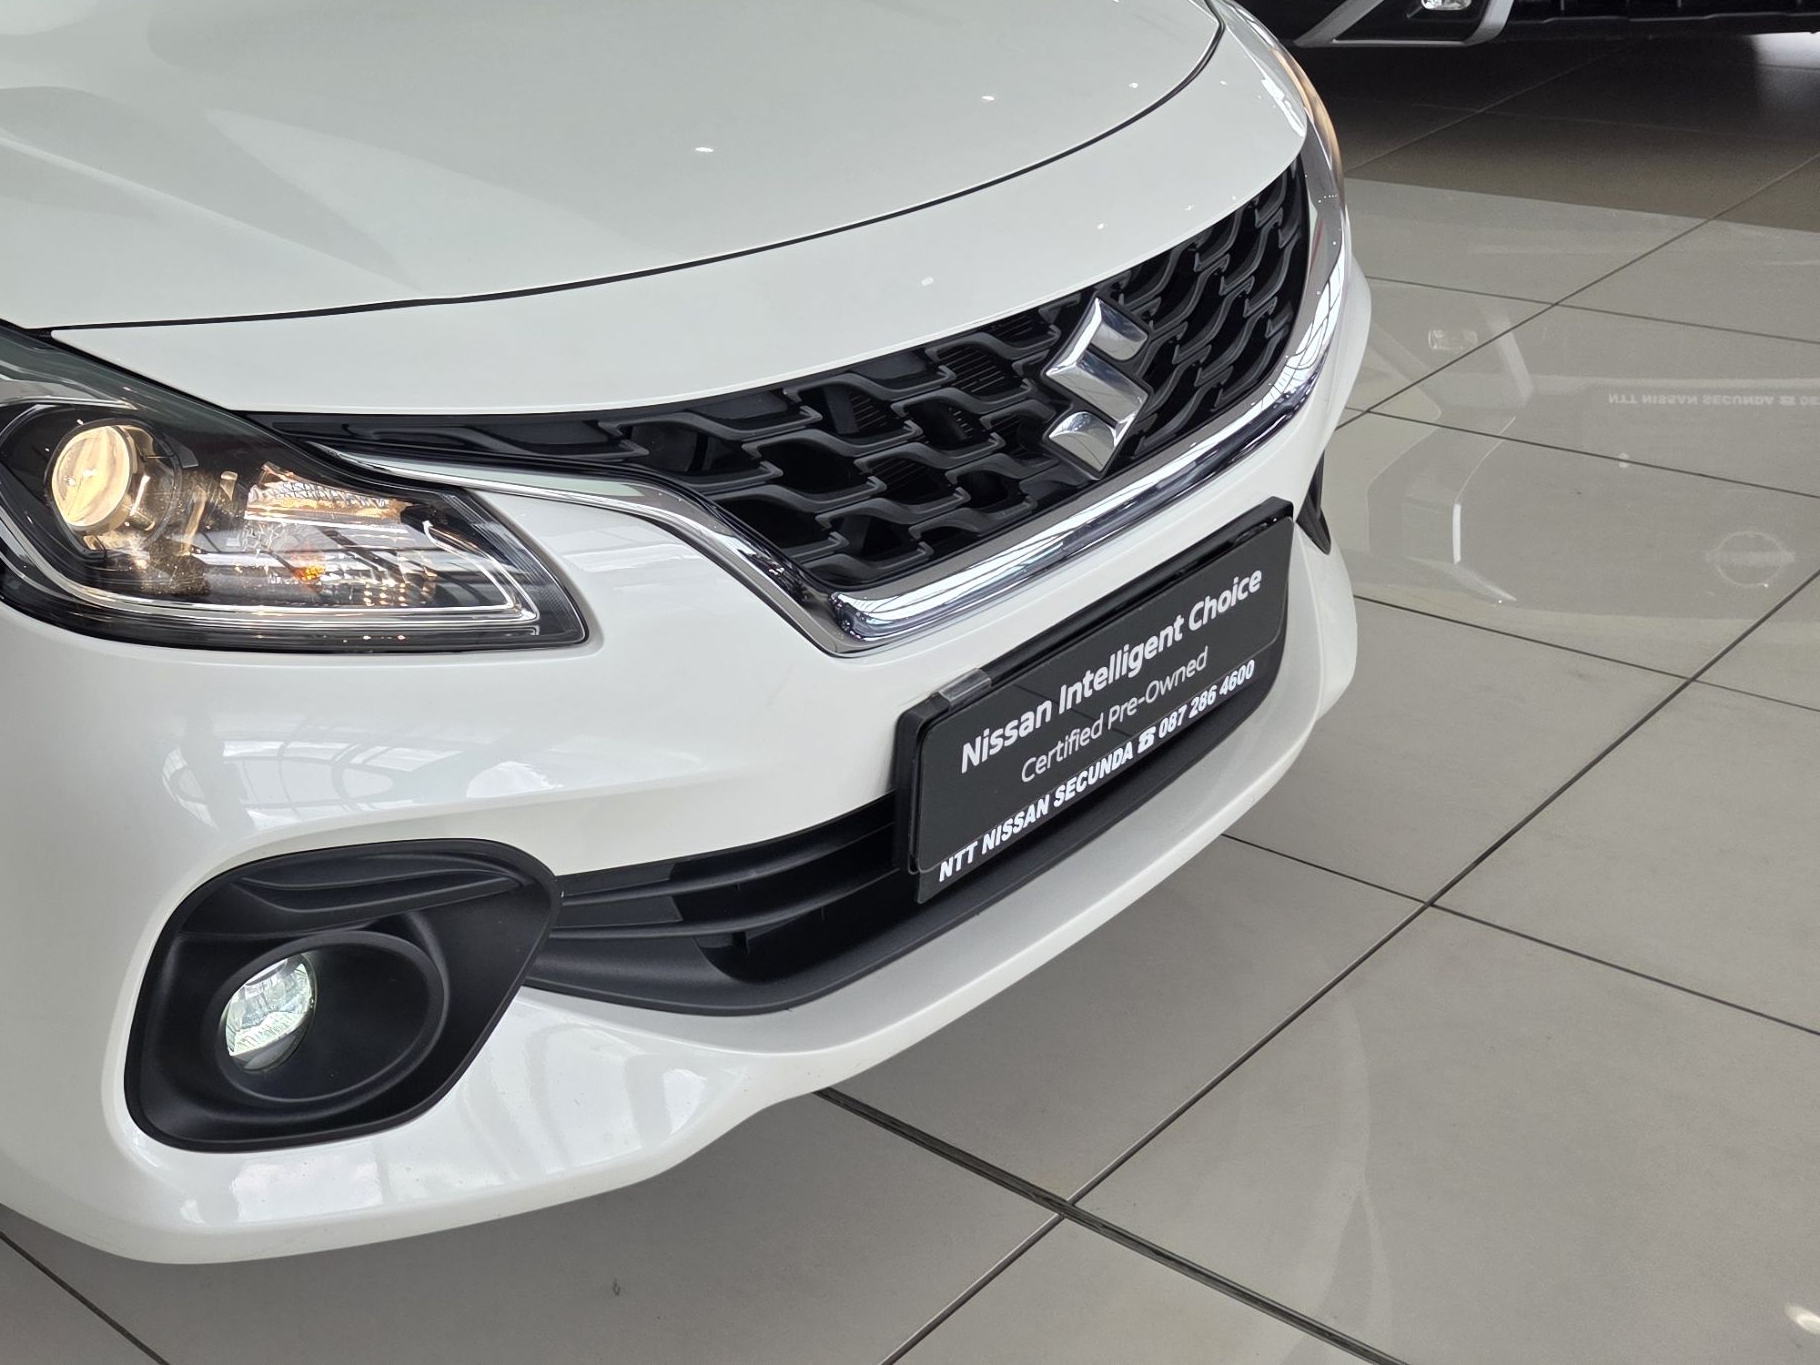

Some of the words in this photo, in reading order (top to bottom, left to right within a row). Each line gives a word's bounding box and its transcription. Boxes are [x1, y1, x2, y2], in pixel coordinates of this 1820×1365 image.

[938, 840, 979, 883] NTT
[981, 795, 1049, 855] NISSAN
[1053, 745, 1134, 808] SECUNDA
[1158, 710, 1187, 740] 087
[1189, 689, 1218, 718] 286
[1219, 659, 1255, 697] 4600
[960, 699, 1052, 774] Nissan
[1058, 614, 1185, 715] Intelligent
[1188, 569, 1263, 631] Choice
[1020, 713, 1103, 783] Certified
[1107, 646, 1209, 731] Pre-Owned
